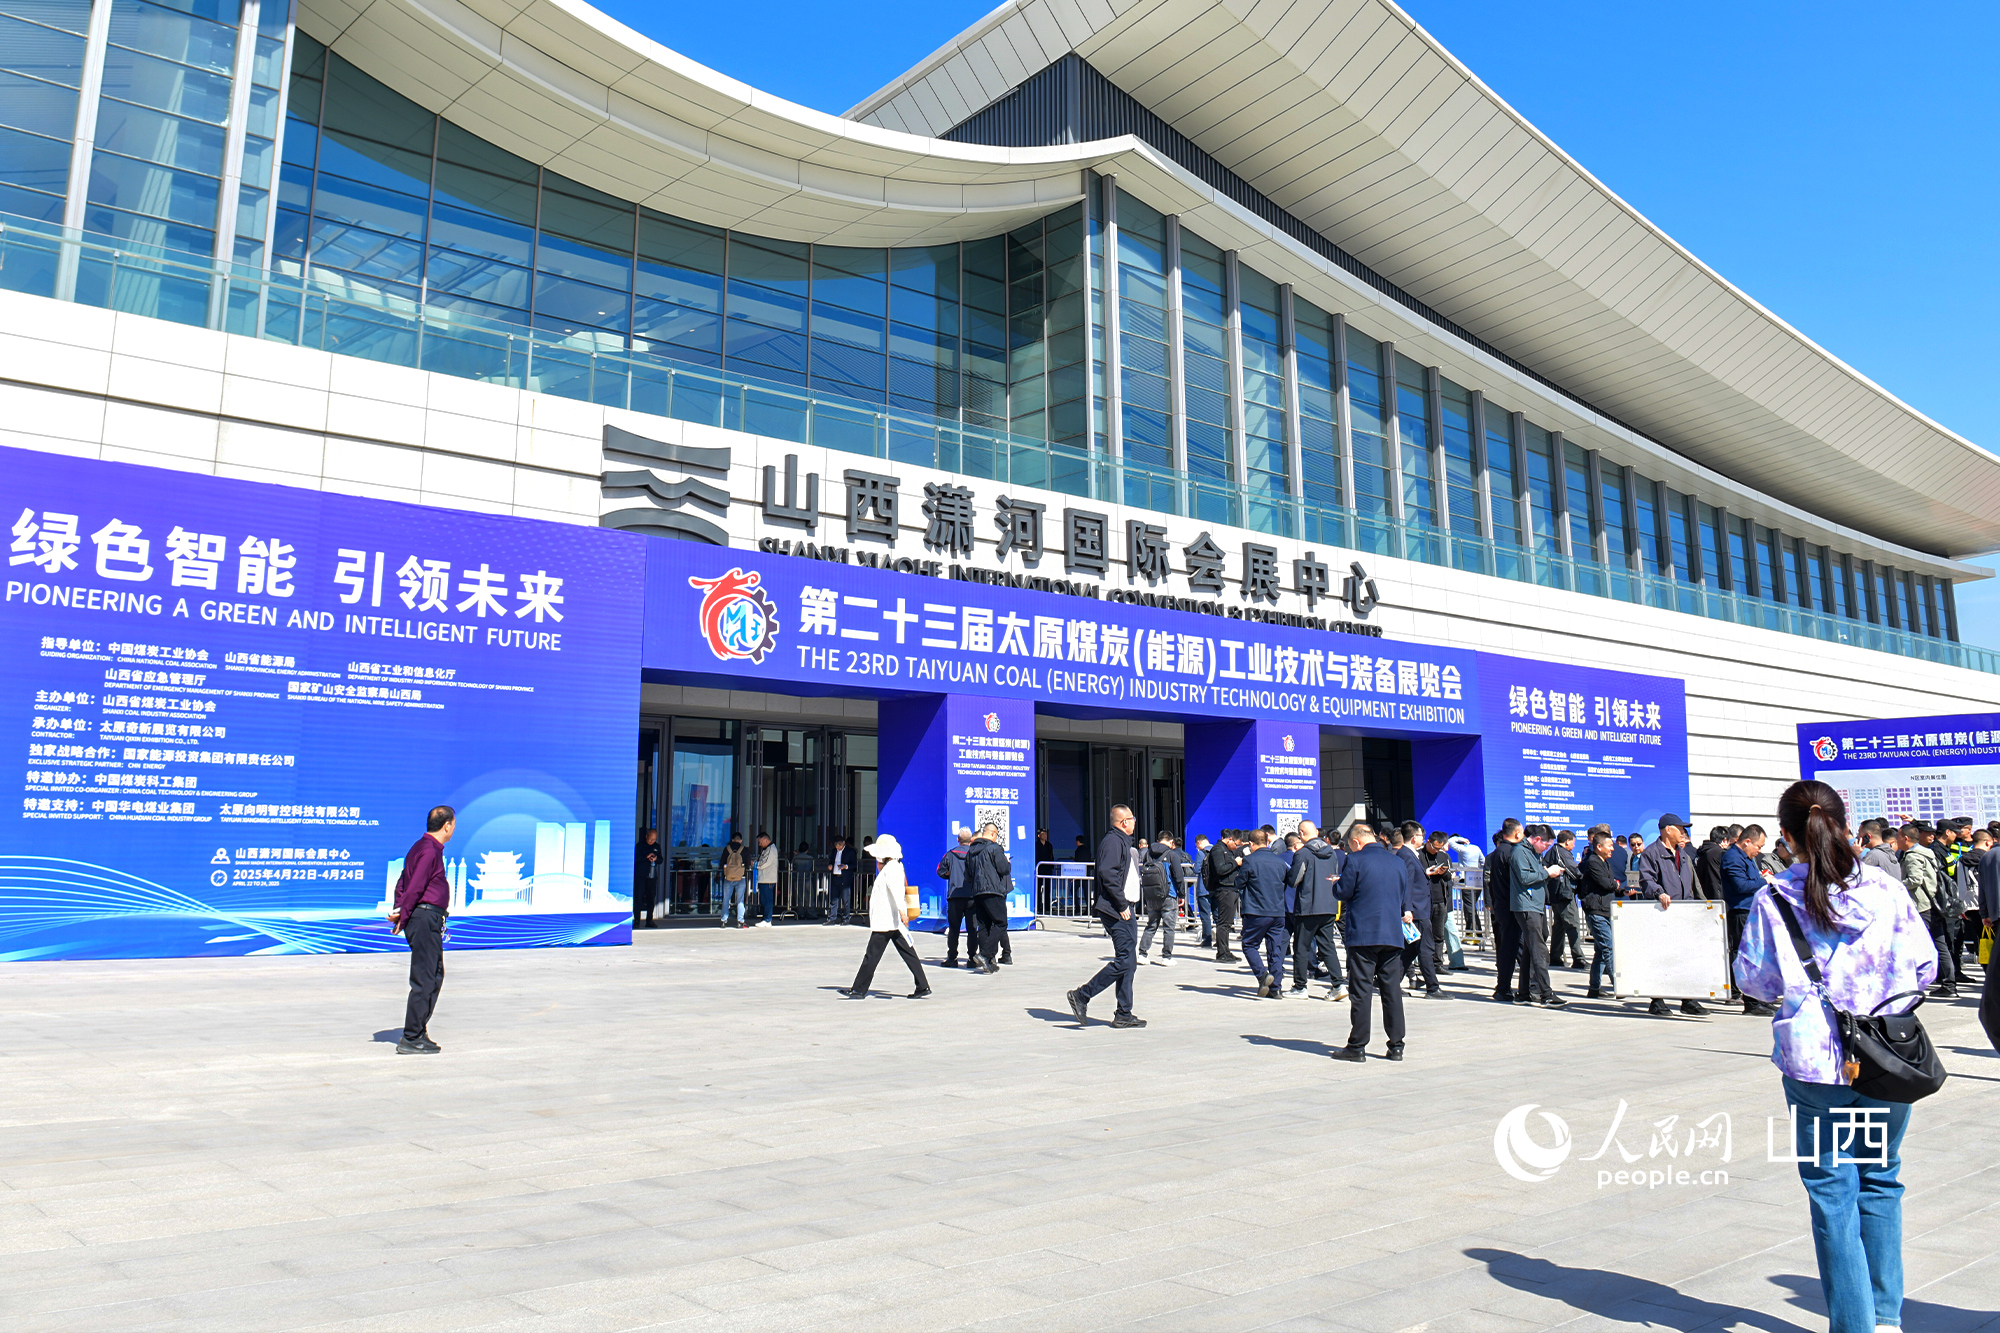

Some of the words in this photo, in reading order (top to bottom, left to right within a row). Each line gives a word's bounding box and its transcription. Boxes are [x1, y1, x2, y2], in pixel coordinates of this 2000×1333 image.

[762, 454, 1380, 613] 山西潇河国际会展中心
[9, 507, 297, 597] 绿色智能
[334, 548, 565, 623] 引领未来
[6, 581, 161, 615] PIONEERING
[173, 598, 188, 617] A
[201, 601, 277, 626] GREEN
[288, 610, 334, 630] AND
[345, 615, 478, 643] INTELLIGENT
[487, 628, 561, 651] FUTURE
[1227, 605, 1243, 621] &
[799, 586, 1462, 700] 第二十三届太原煤炭(能源)工业技术与装备展览会
[67, 653, 112, 661] ORGANIZATION:
[225, 651, 295, 668] 山西省能源局
[105, 668, 206, 686] 山西省应急管理厅
[348, 661, 456, 680] 山西省工业和信息化厅
[287, 681, 422, 701] 国家矿山安全监察局山西局
[797, 645, 840, 672] THE
[846, 650, 899, 676] 23RD
[905, 656, 988, 684] TAIYUAN
[994, 664, 1042, 689] COAL
[1047, 668, 1125, 700] (ENERGY)
[1130, 678, 1208, 704] INDUSTRY
[1211, 686, 1307, 712] TECHNOLOGY
[1310, 695, 1320, 713] &
[1323, 696, 1397, 719] EQUIPMENT
[1400, 703, 1465, 725] EXHIBITION
[1509, 685, 1586, 724] 绿色智能
[1594, 697, 1662, 731] 引领未来
[1511, 722, 1552, 736] PIONEERING
[1554, 727, 1560, 736] A
[1562, 727, 1582, 738] GREEN
[1585, 730, 1598, 740] AND
[1600, 731, 1637, 743] INTELLIGENT
[1639, 734, 1661, 745] FUTURE
[1859, 752, 1877, 760] 23RD
[1932, 748, 1967, 757] (ENERGY)
[219, 803, 360, 819] 太原向明智控科技有限公司
[235, 847, 351, 860] 山西潇河国际会展中心
[233, 869, 364, 881] 2025年4月22日-4月24日
